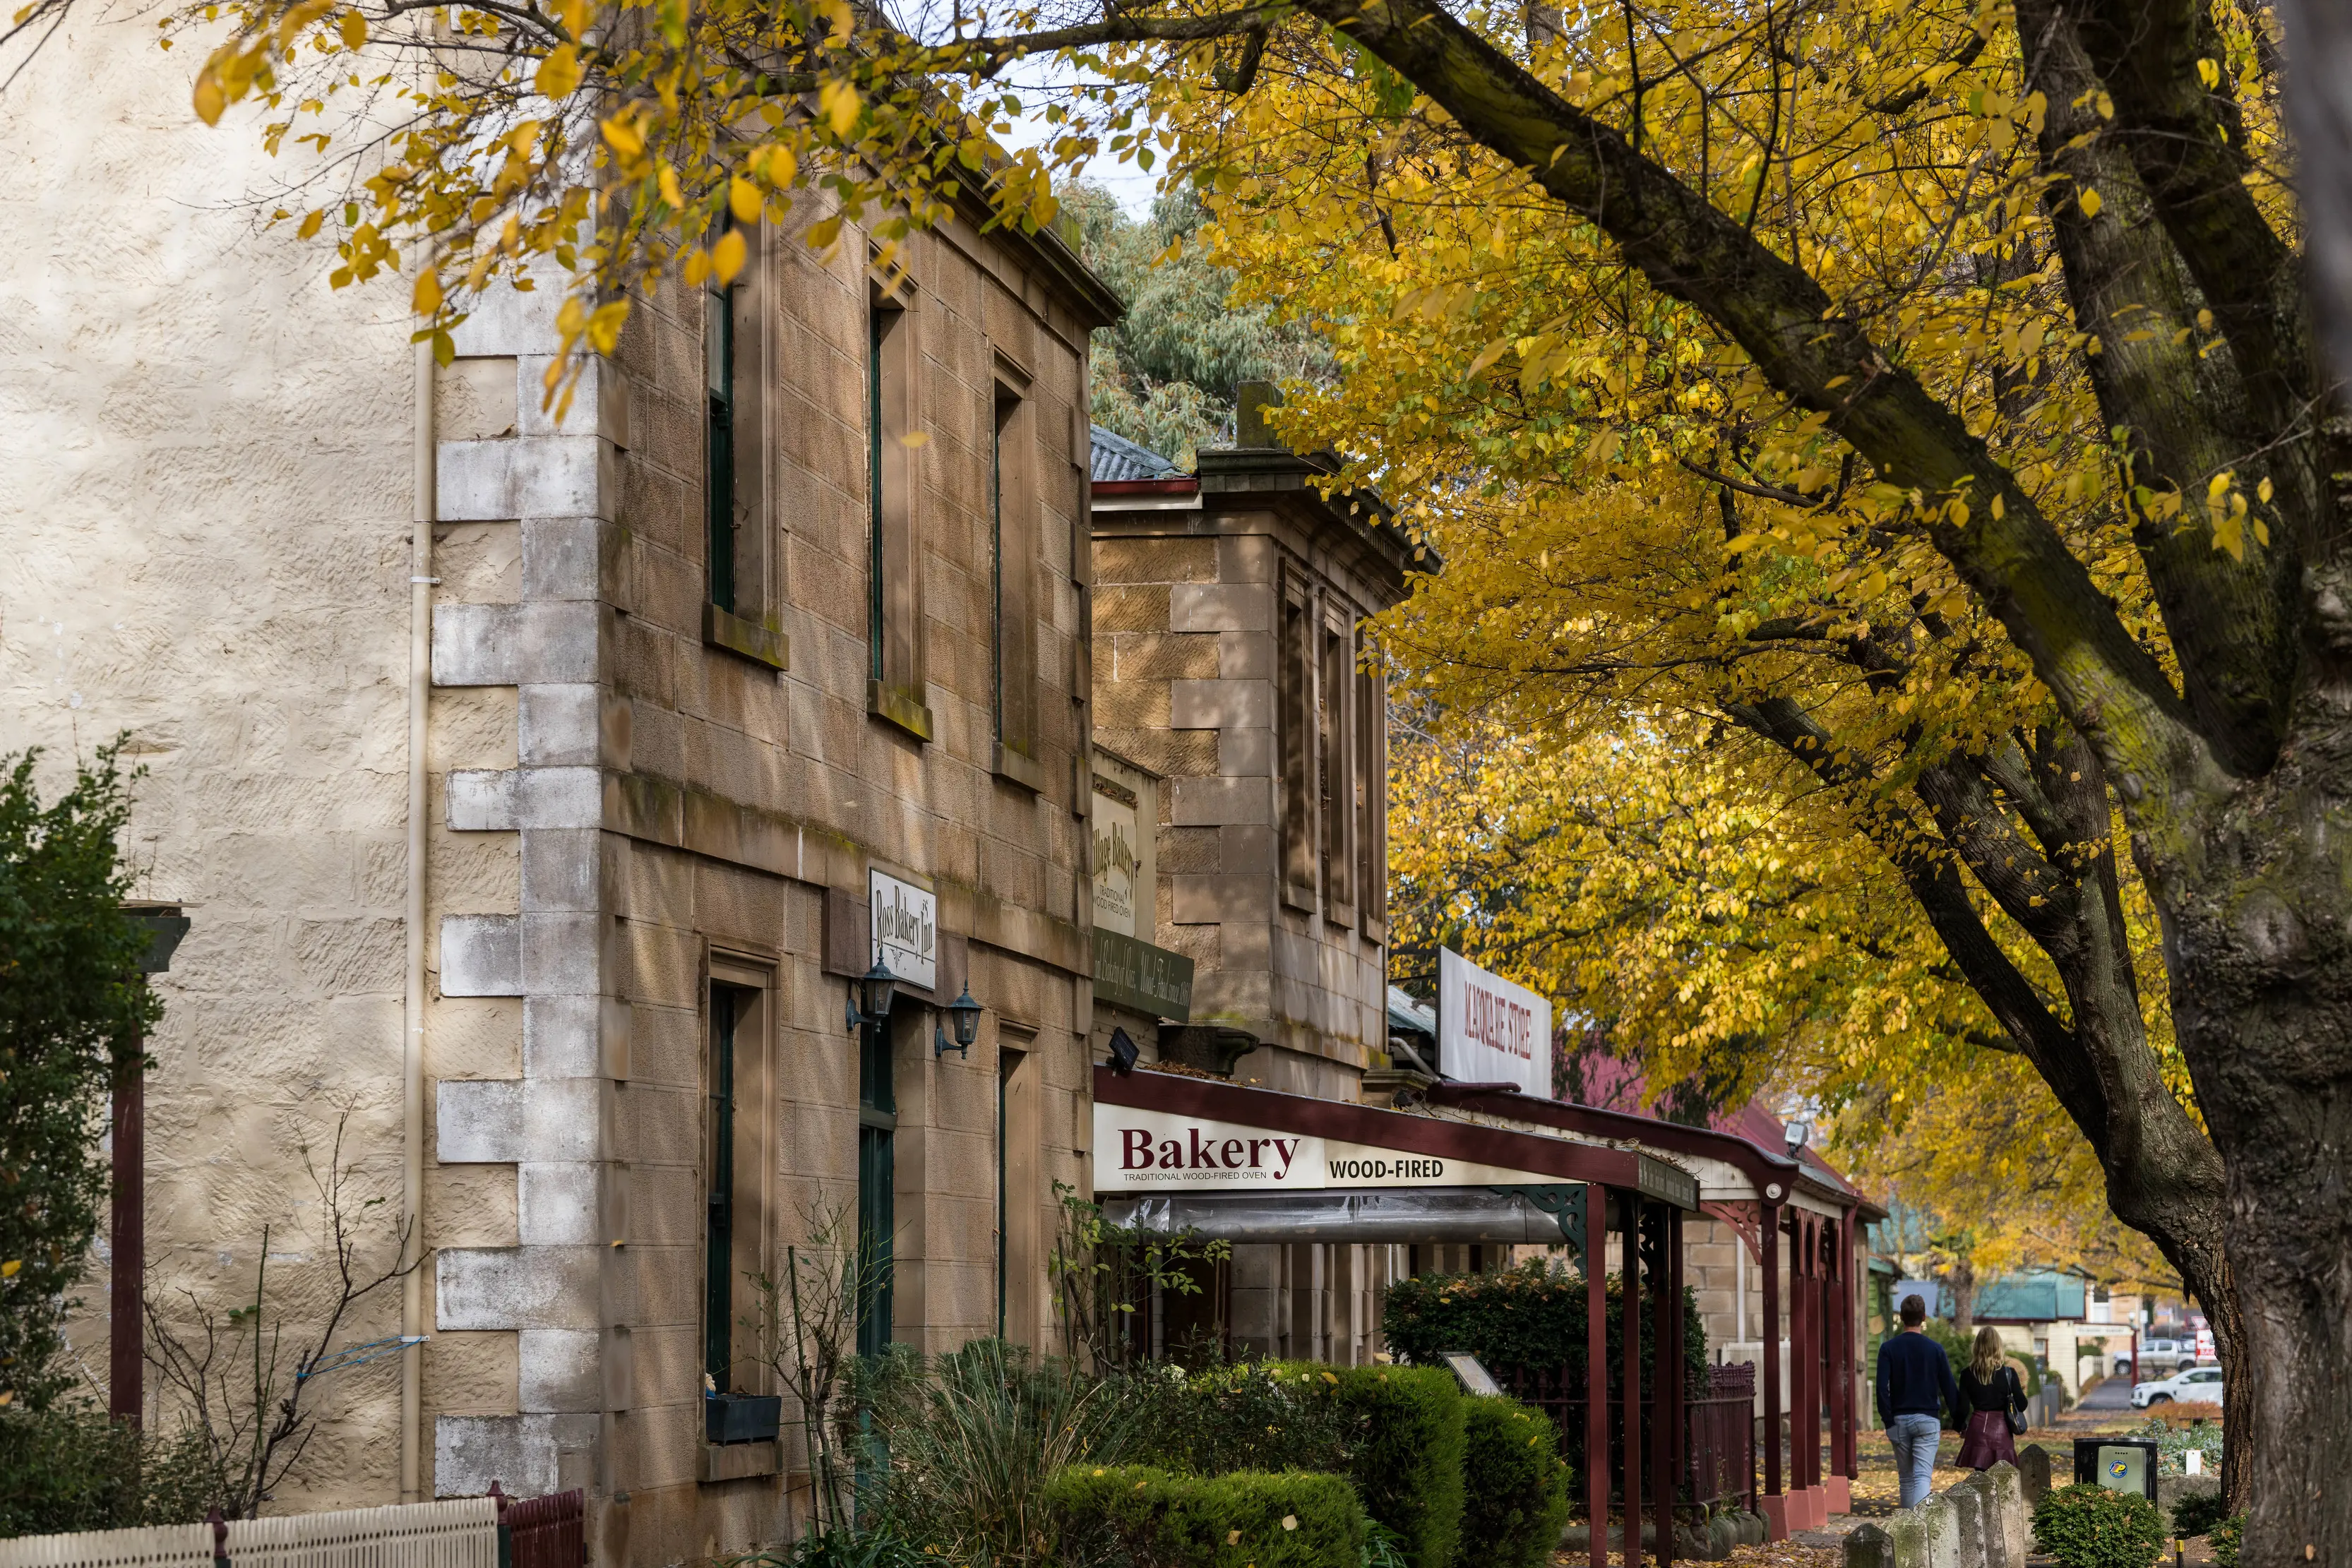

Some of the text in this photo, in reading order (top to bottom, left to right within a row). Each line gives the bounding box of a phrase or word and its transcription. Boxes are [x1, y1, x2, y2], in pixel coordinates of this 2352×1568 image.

[1093, 822, 1133, 900] illage Bakery
[1092, 895, 1130, 918] WOOD FIRED OVEN
[1099, 884, 1126, 904] TRADITIONAL
[876, 885, 932, 964] Ross Bakery Inn
[1508, 1002, 1531, 1060] STRE
[1118, 1128, 1301, 1180] Bakery
[1330, 1160, 1443, 1178] WOOD-FIRED
[1123, 1173, 1181, 1181] TRADITIONAL
[1183, 1172, 1240, 1180] WOOD-FIRED
